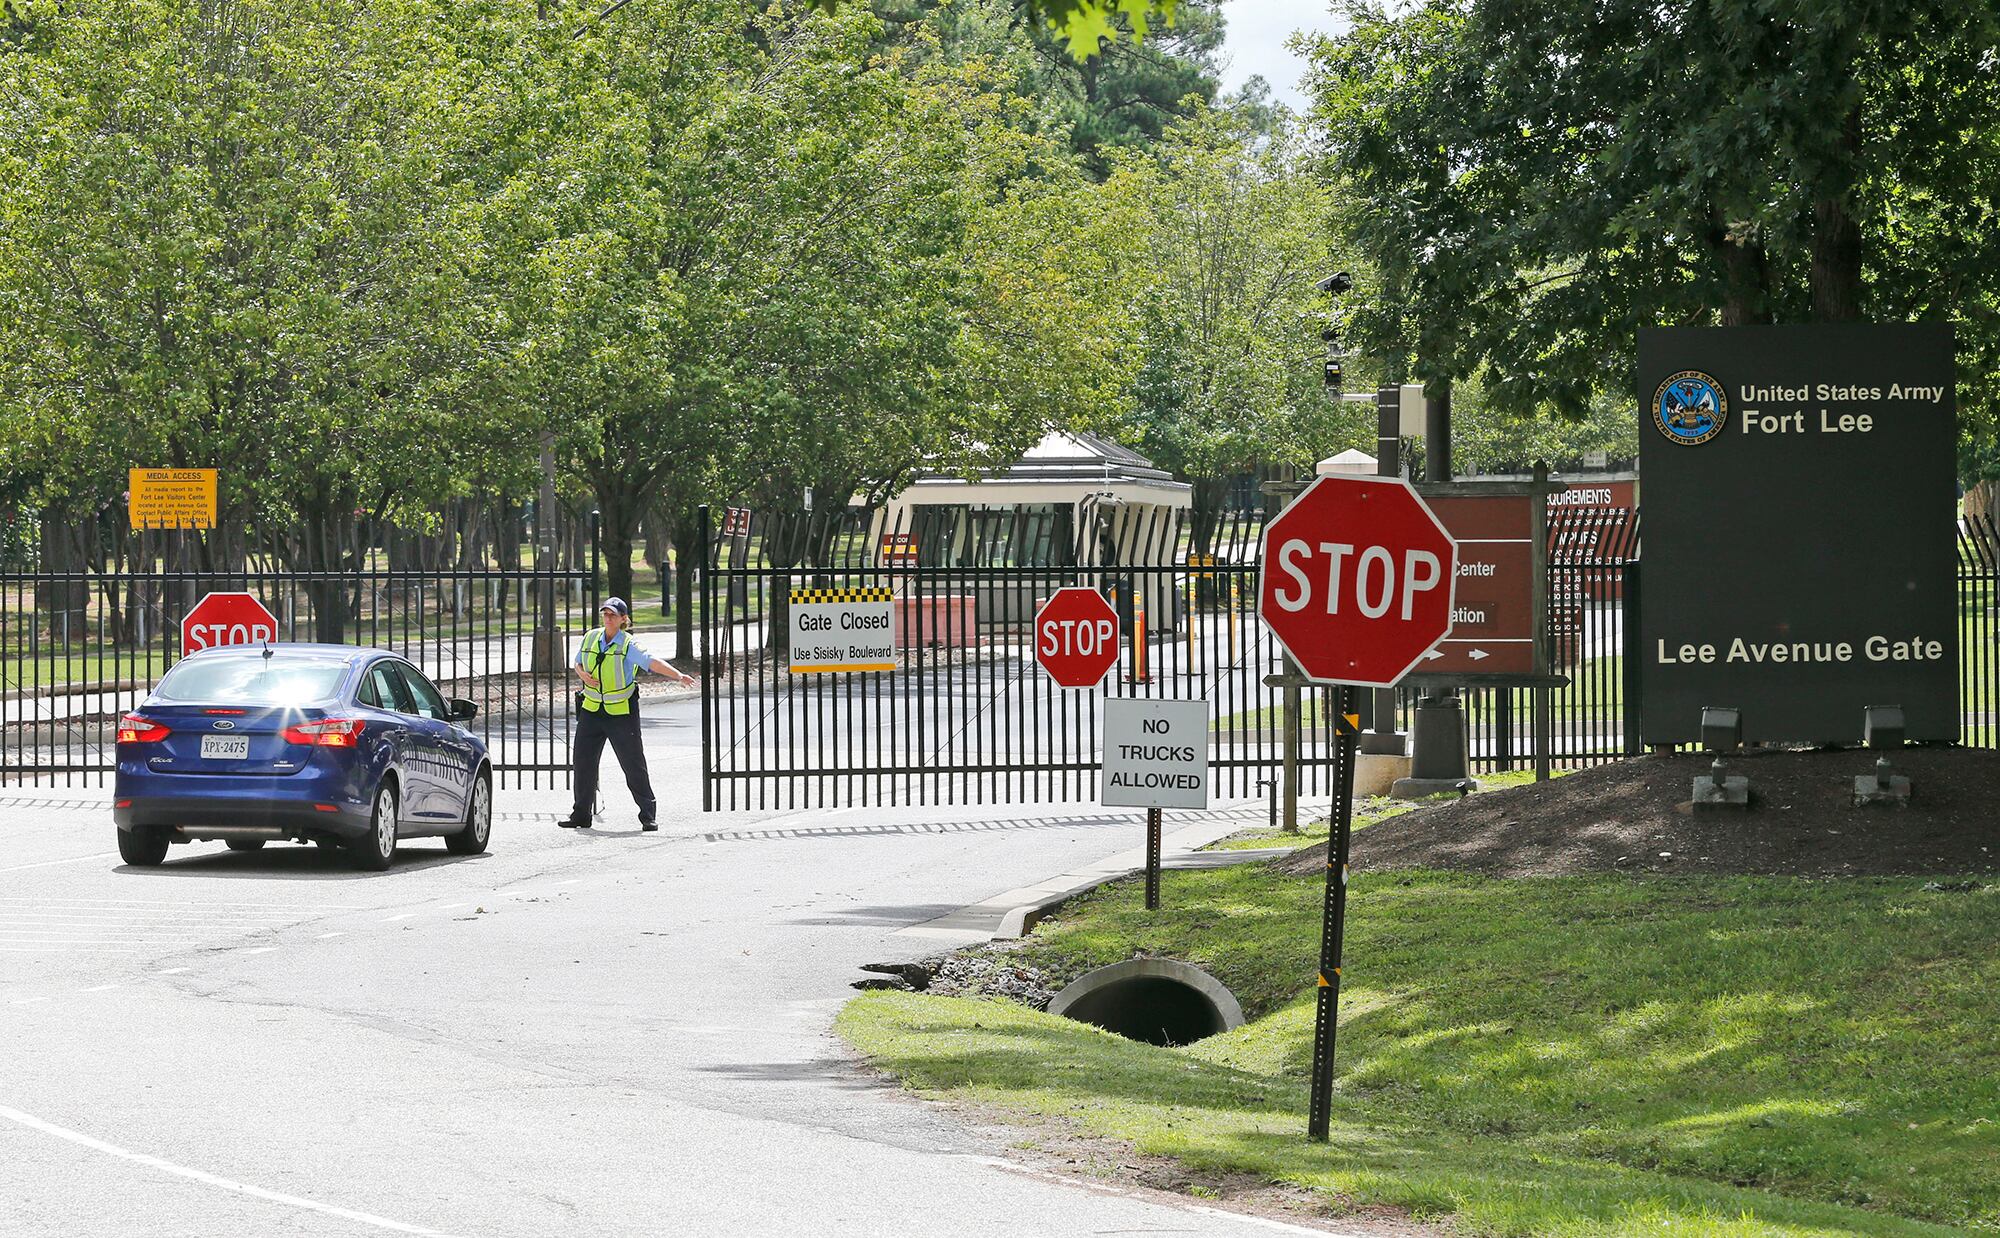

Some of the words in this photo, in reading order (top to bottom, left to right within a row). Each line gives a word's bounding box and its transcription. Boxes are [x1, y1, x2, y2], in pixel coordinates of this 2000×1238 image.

[1741, 384, 1809, 402] United
[1816, 383, 1881, 401] States
[1887, 383, 1944, 404] Army
[1742, 409, 1805, 434] Fort
[1820, 409, 1874, 433] Lee
[146, 472, 169, 480] MEDIA
[173, 472, 202, 480] ACCESS
[1274, 538, 1441, 621] STOP
[799, 613, 832, 631] Gate
[840, 611, 889, 630] Closed
[189, 623, 271, 653] STOP
[1042, 619, 1113, 657] STOP
[794, 647, 811, 660] Use
[813, 646, 845, 661] Sisisky
[849, 644, 892, 659] Boulevard
[1658, 638, 1716, 664] Lee
[1726, 637, 1853, 663] Avenue
[1864, 635, 1943, 661] Gate
[1143, 719, 1170, 734] NO
[203, 741, 245, 753] XPX-2475
[1119, 744, 1195, 762] TRUCKS
[1110, 772, 1201, 790] ALLOWED
